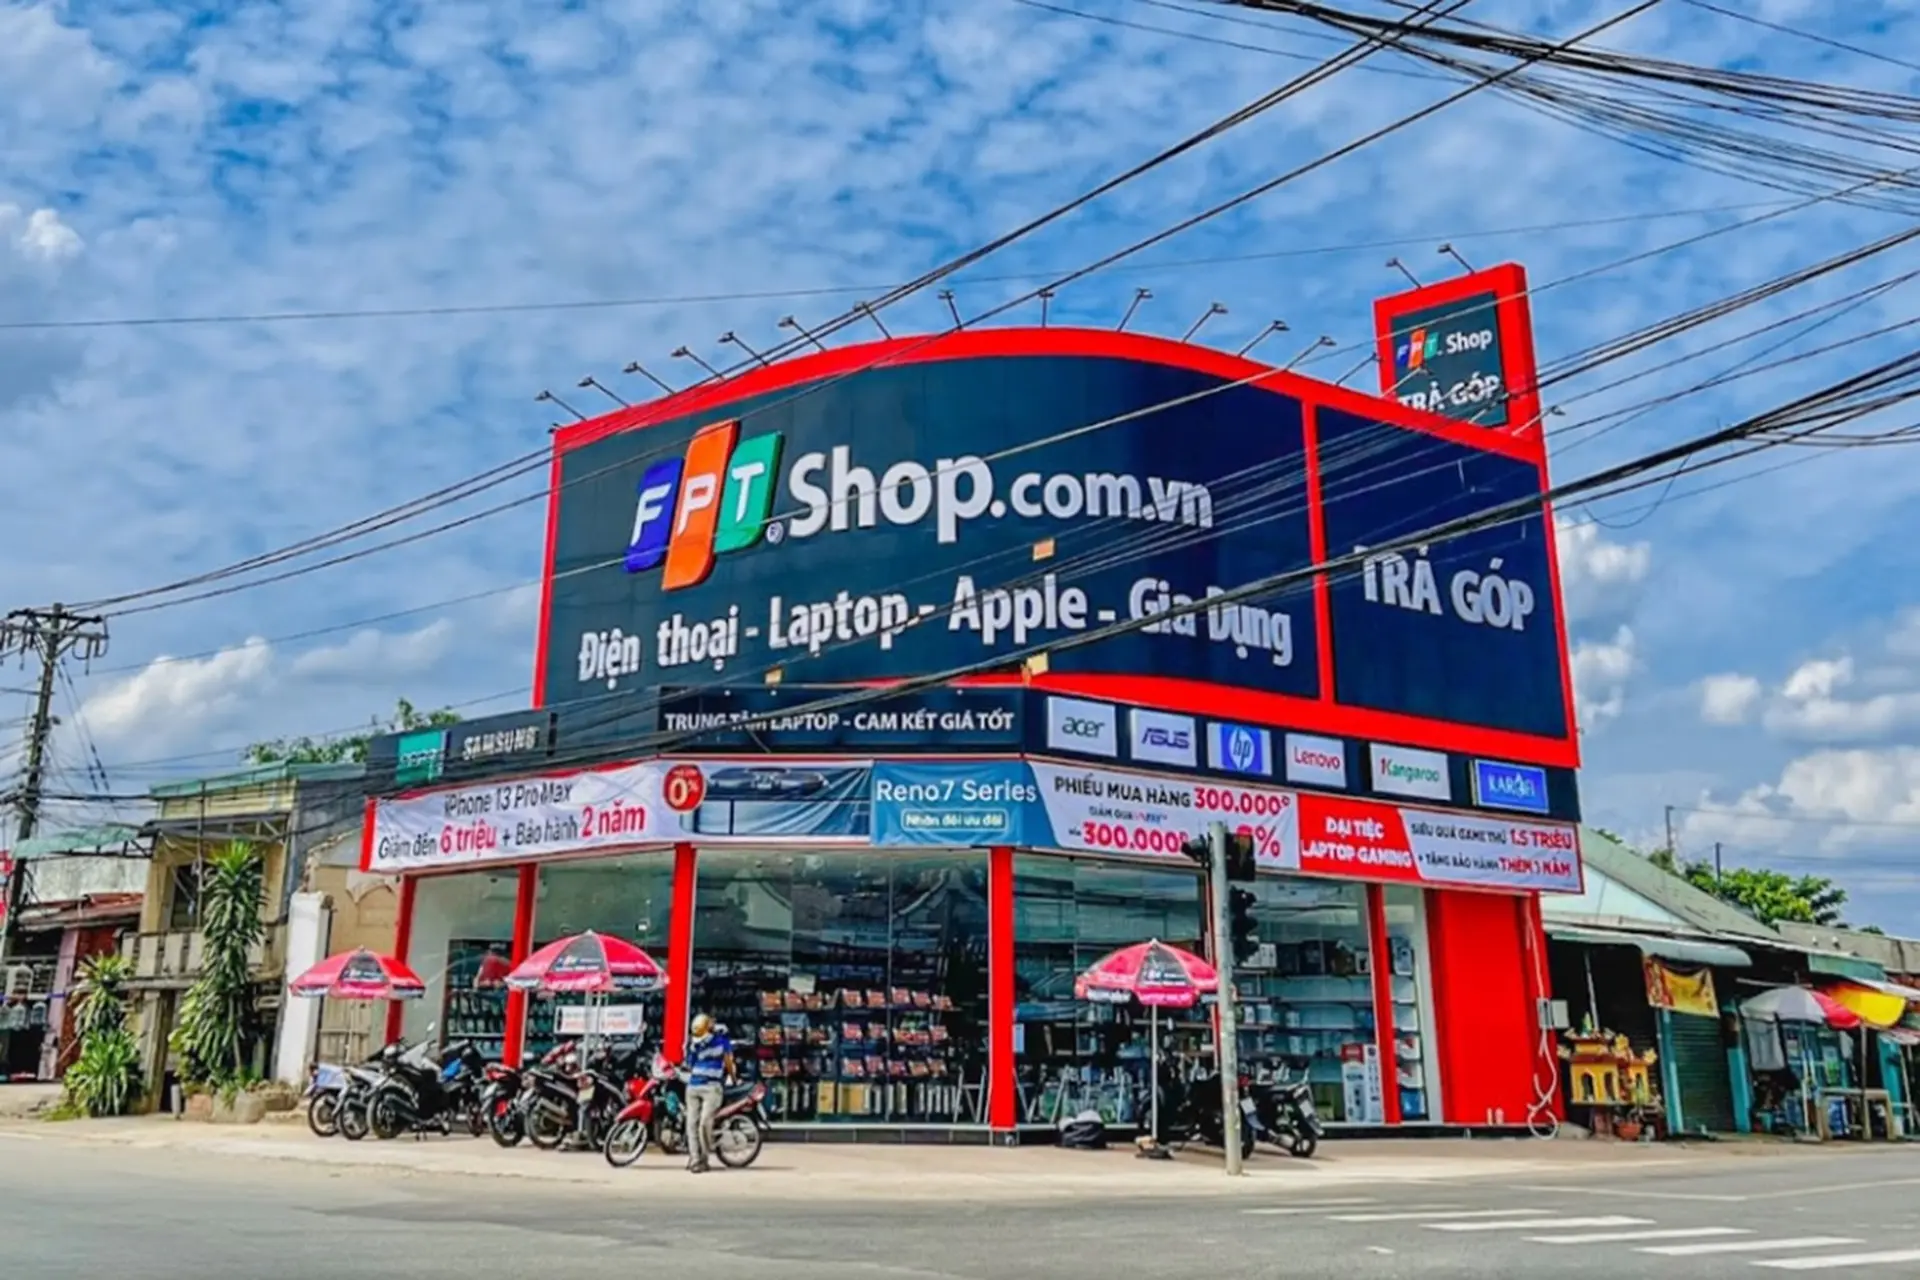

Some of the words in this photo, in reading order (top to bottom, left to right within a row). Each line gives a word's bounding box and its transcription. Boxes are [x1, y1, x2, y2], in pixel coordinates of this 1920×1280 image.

[1446, 329, 1493, 354] Shop
[1450, 371, 1500, 405] GÓP
[787, 444, 1214, 544] Shop.com.vn
[1354, 543, 1443, 616] TRẢ
[1450, 556, 1536, 632] GÓP
[578, 627, 641, 690] Điện
[657, 604, 740, 671] thoại
[768, 590, 910, 657] Laptop
[948, 574, 1088, 645] Apple
[1128, 577, 1197, 638] Gia
[1206, 585, 1293, 667] Dụng
[664, 712, 727, 731] TRUNG
[854, 712, 897, 731] CAM
[901, 707, 937, 731] KẾT
[940, 707, 974, 731] GIÁ
[976, 706, 1015, 731] TỐT
[1061, 715, 1105, 739] acer
[463, 726, 539, 760] SAMSUNG
[1141, 726, 1190, 750] ASUS
[1233, 725, 1253, 769] hp
[1294, 746, 1341, 770] Lenovo
[444, 793, 492, 817] iPhone
[496, 786, 512, 811] 13
[876, 778, 955, 802] Reno7
[961, 778, 1038, 803] Series
[1054, 771, 1102, 797] PHIẾU
[1106, 782, 1143, 801] MUA
[1145, 787, 1191, 808] HÀNG
[440, 824, 453, 854] 6
[455, 818, 497, 858] triệu
[581, 805, 594, 838] 2
[598, 799, 646, 835] năm
[1301, 839, 1356, 862] LAPTOP
